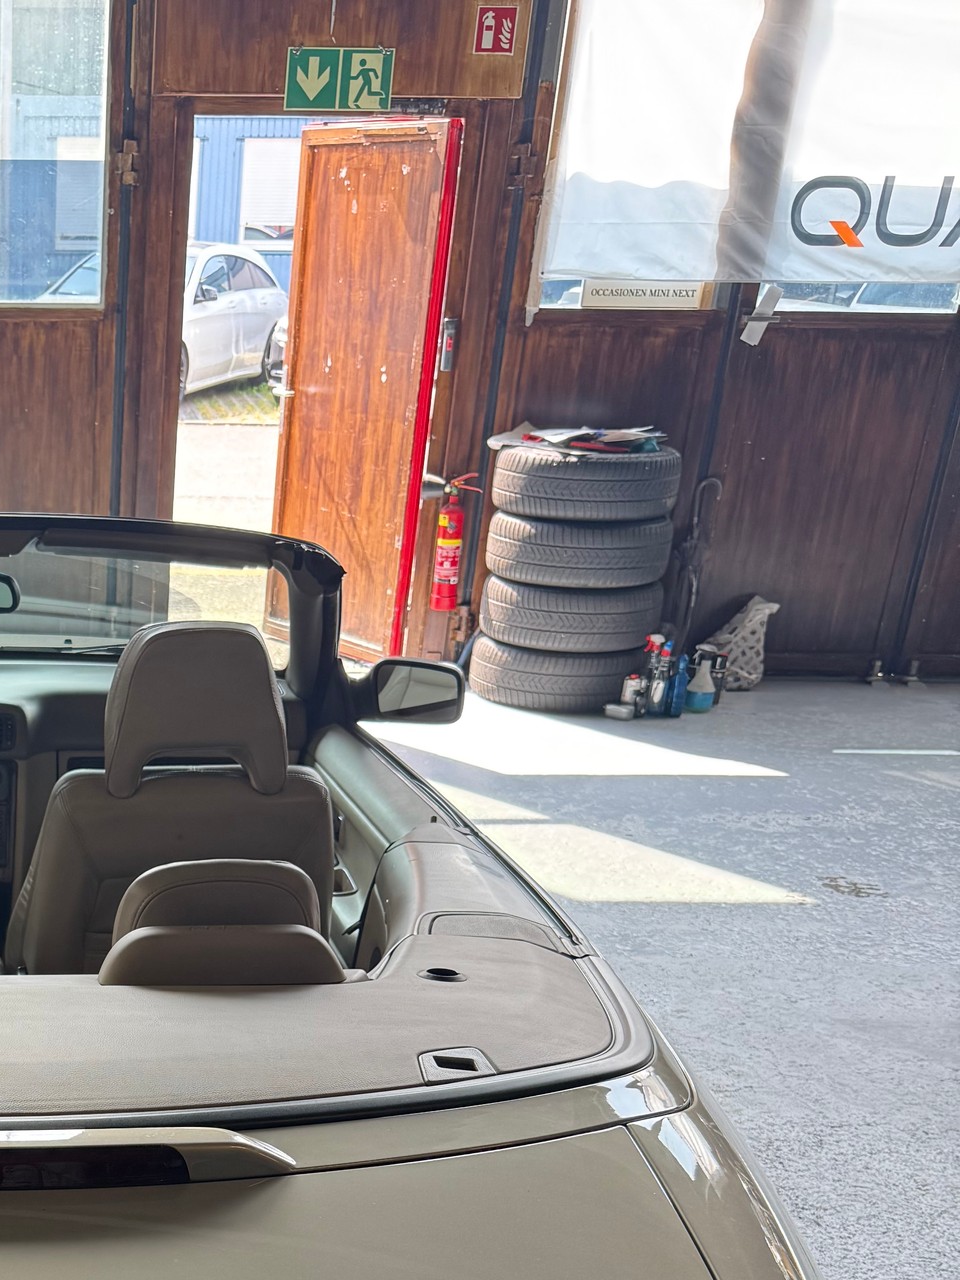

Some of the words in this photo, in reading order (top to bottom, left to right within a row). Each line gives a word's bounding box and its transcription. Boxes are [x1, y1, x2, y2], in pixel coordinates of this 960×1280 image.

[791, 175, 960, 248] QU
[590, 287, 647, 298] OCCASIONEN
[648, 288, 671, 298] MINI
[671, 288, 697, 299] NEXT
